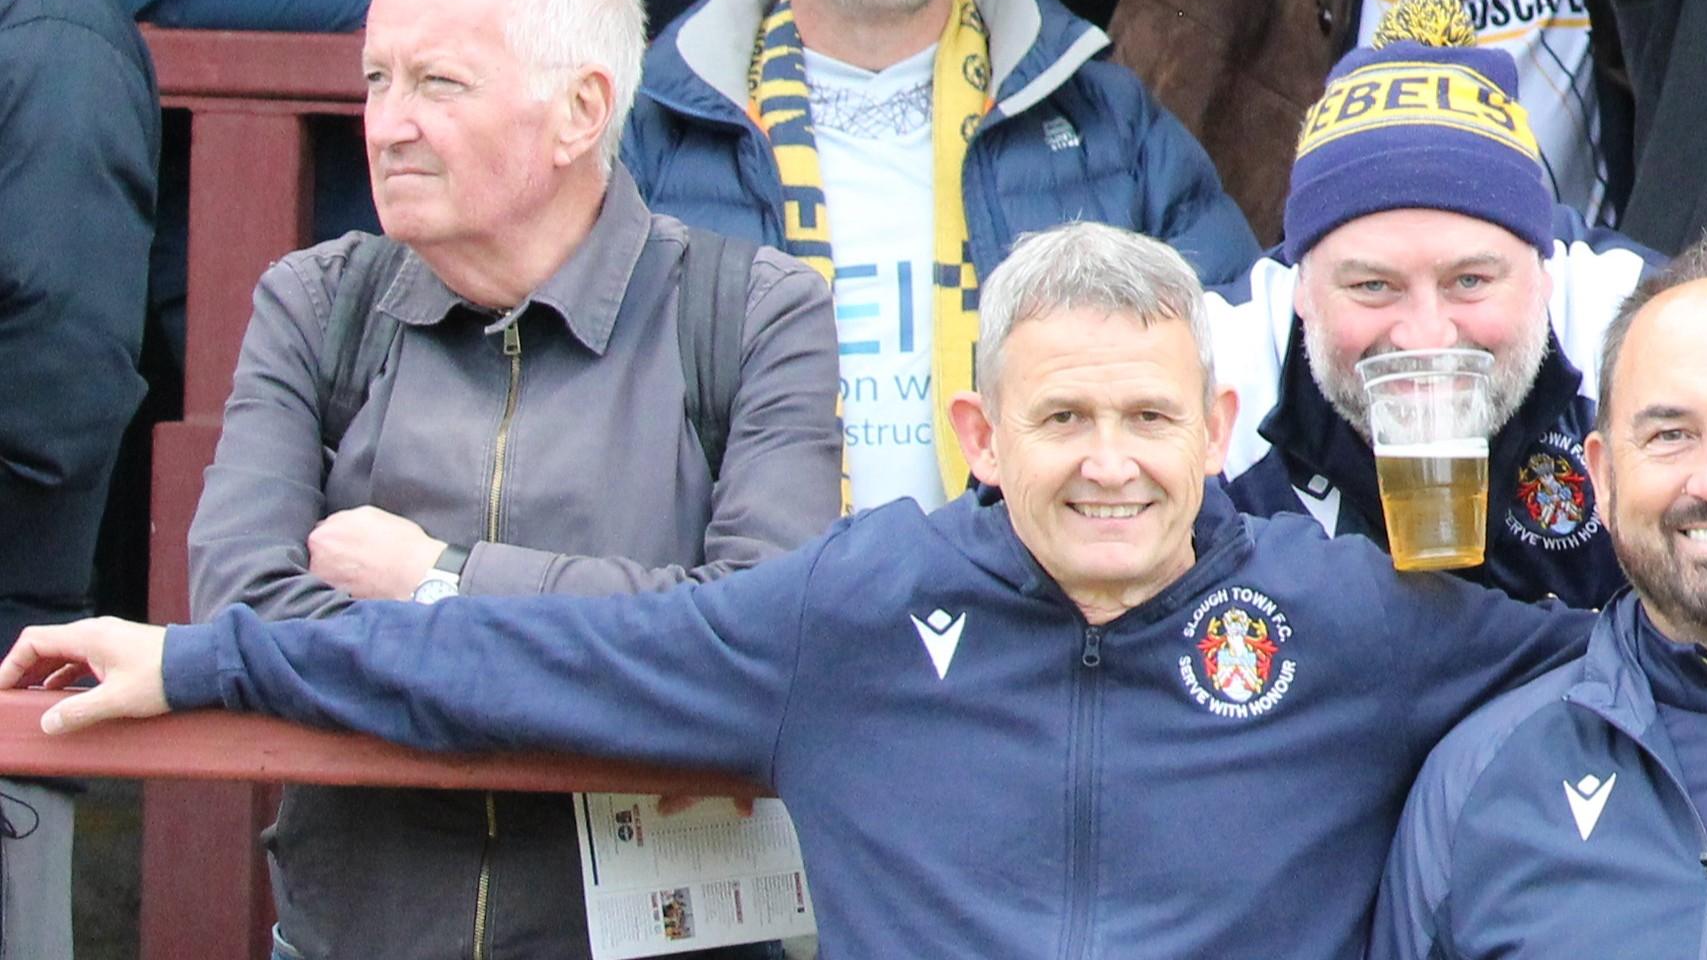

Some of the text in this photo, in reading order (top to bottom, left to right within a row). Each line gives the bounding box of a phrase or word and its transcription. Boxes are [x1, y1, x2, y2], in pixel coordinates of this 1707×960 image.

[1504, 507, 1542, 546] ERVE
[1542, 534, 1580, 551] WITH
[1183, 588, 1229, 639] SLOUGH
[1232, 586, 1277, 617] TOWN
[1178, 655, 1297, 719] SERVE WITH HONOUR
